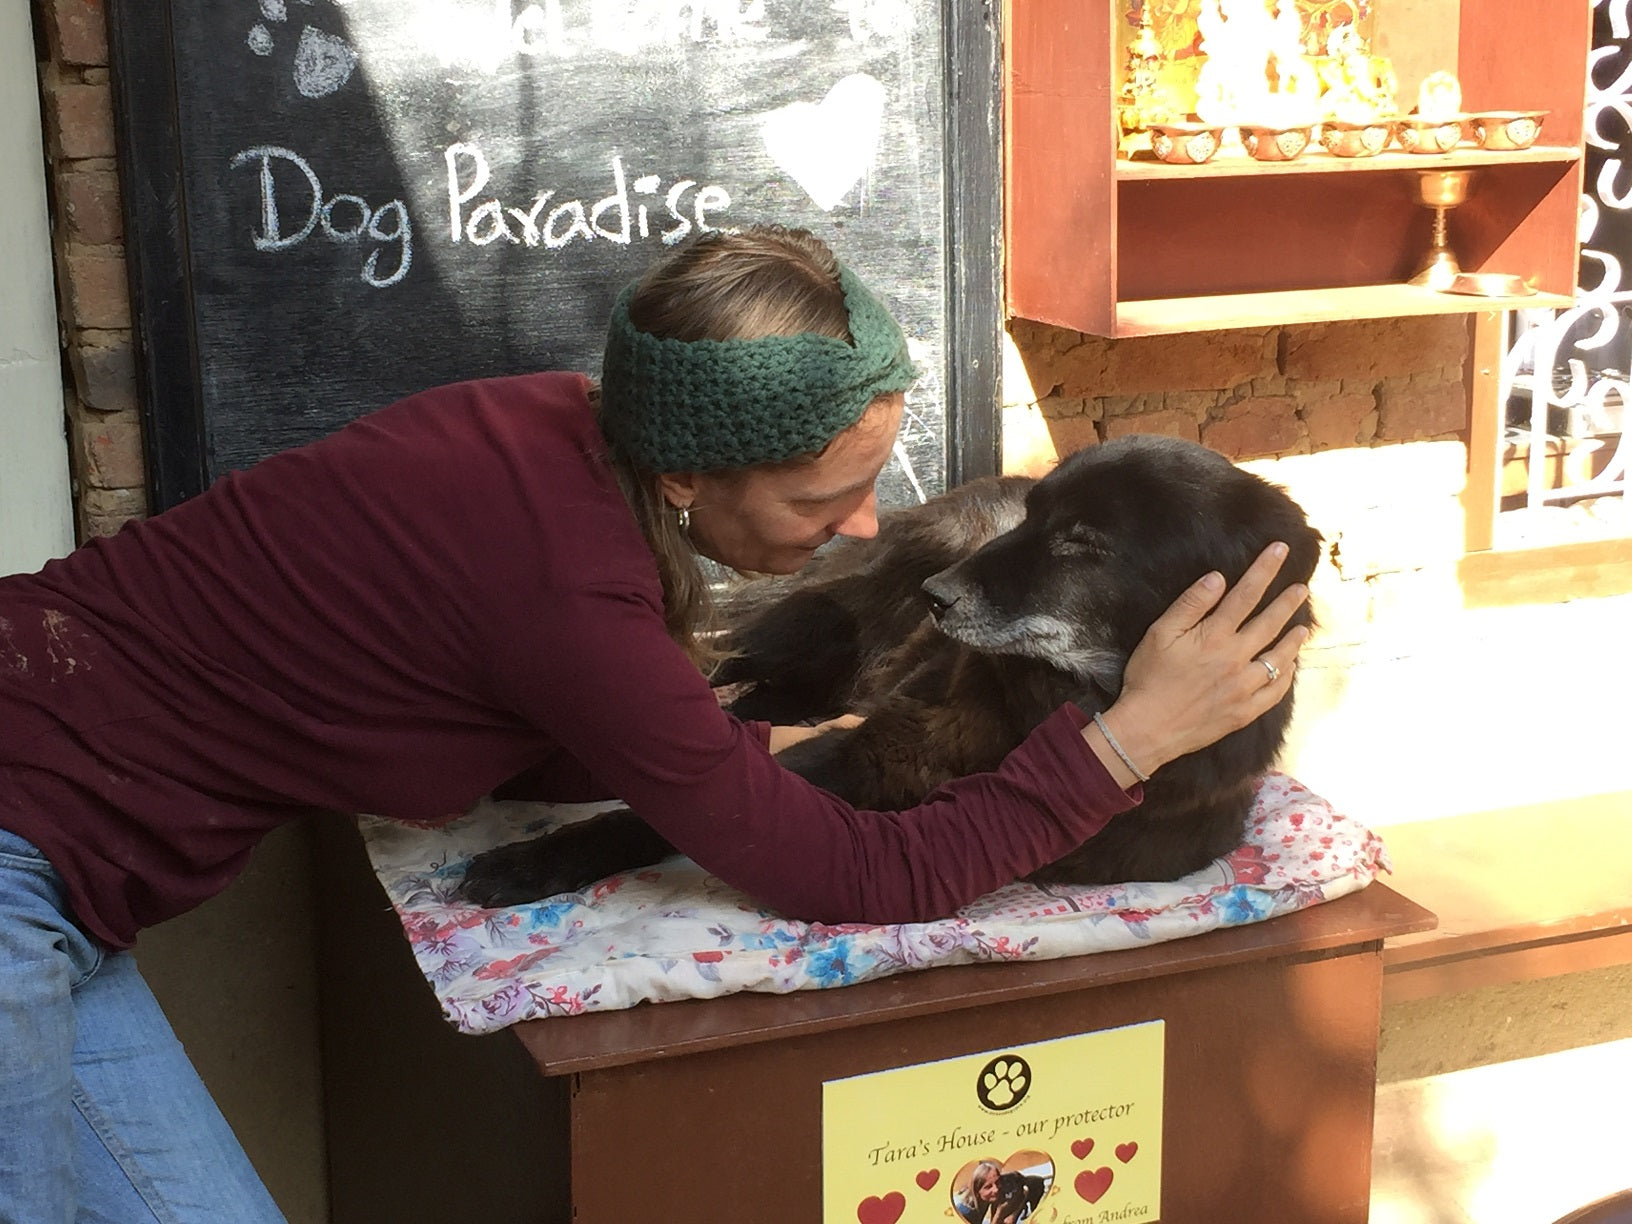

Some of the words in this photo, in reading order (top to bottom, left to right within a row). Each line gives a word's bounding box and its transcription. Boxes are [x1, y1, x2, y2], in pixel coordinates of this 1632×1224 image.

[230, 145, 413, 288] Dog
[444, 142, 733, 249] Paradise
[868, 1140, 930, 1166] Tara's
[937, 1126, 996, 1153] House
[1016, 1119, 1049, 1137] our
[1048, 1102, 1136, 1140] protector
[1098, 1202, 1149, 1224] Andrea
